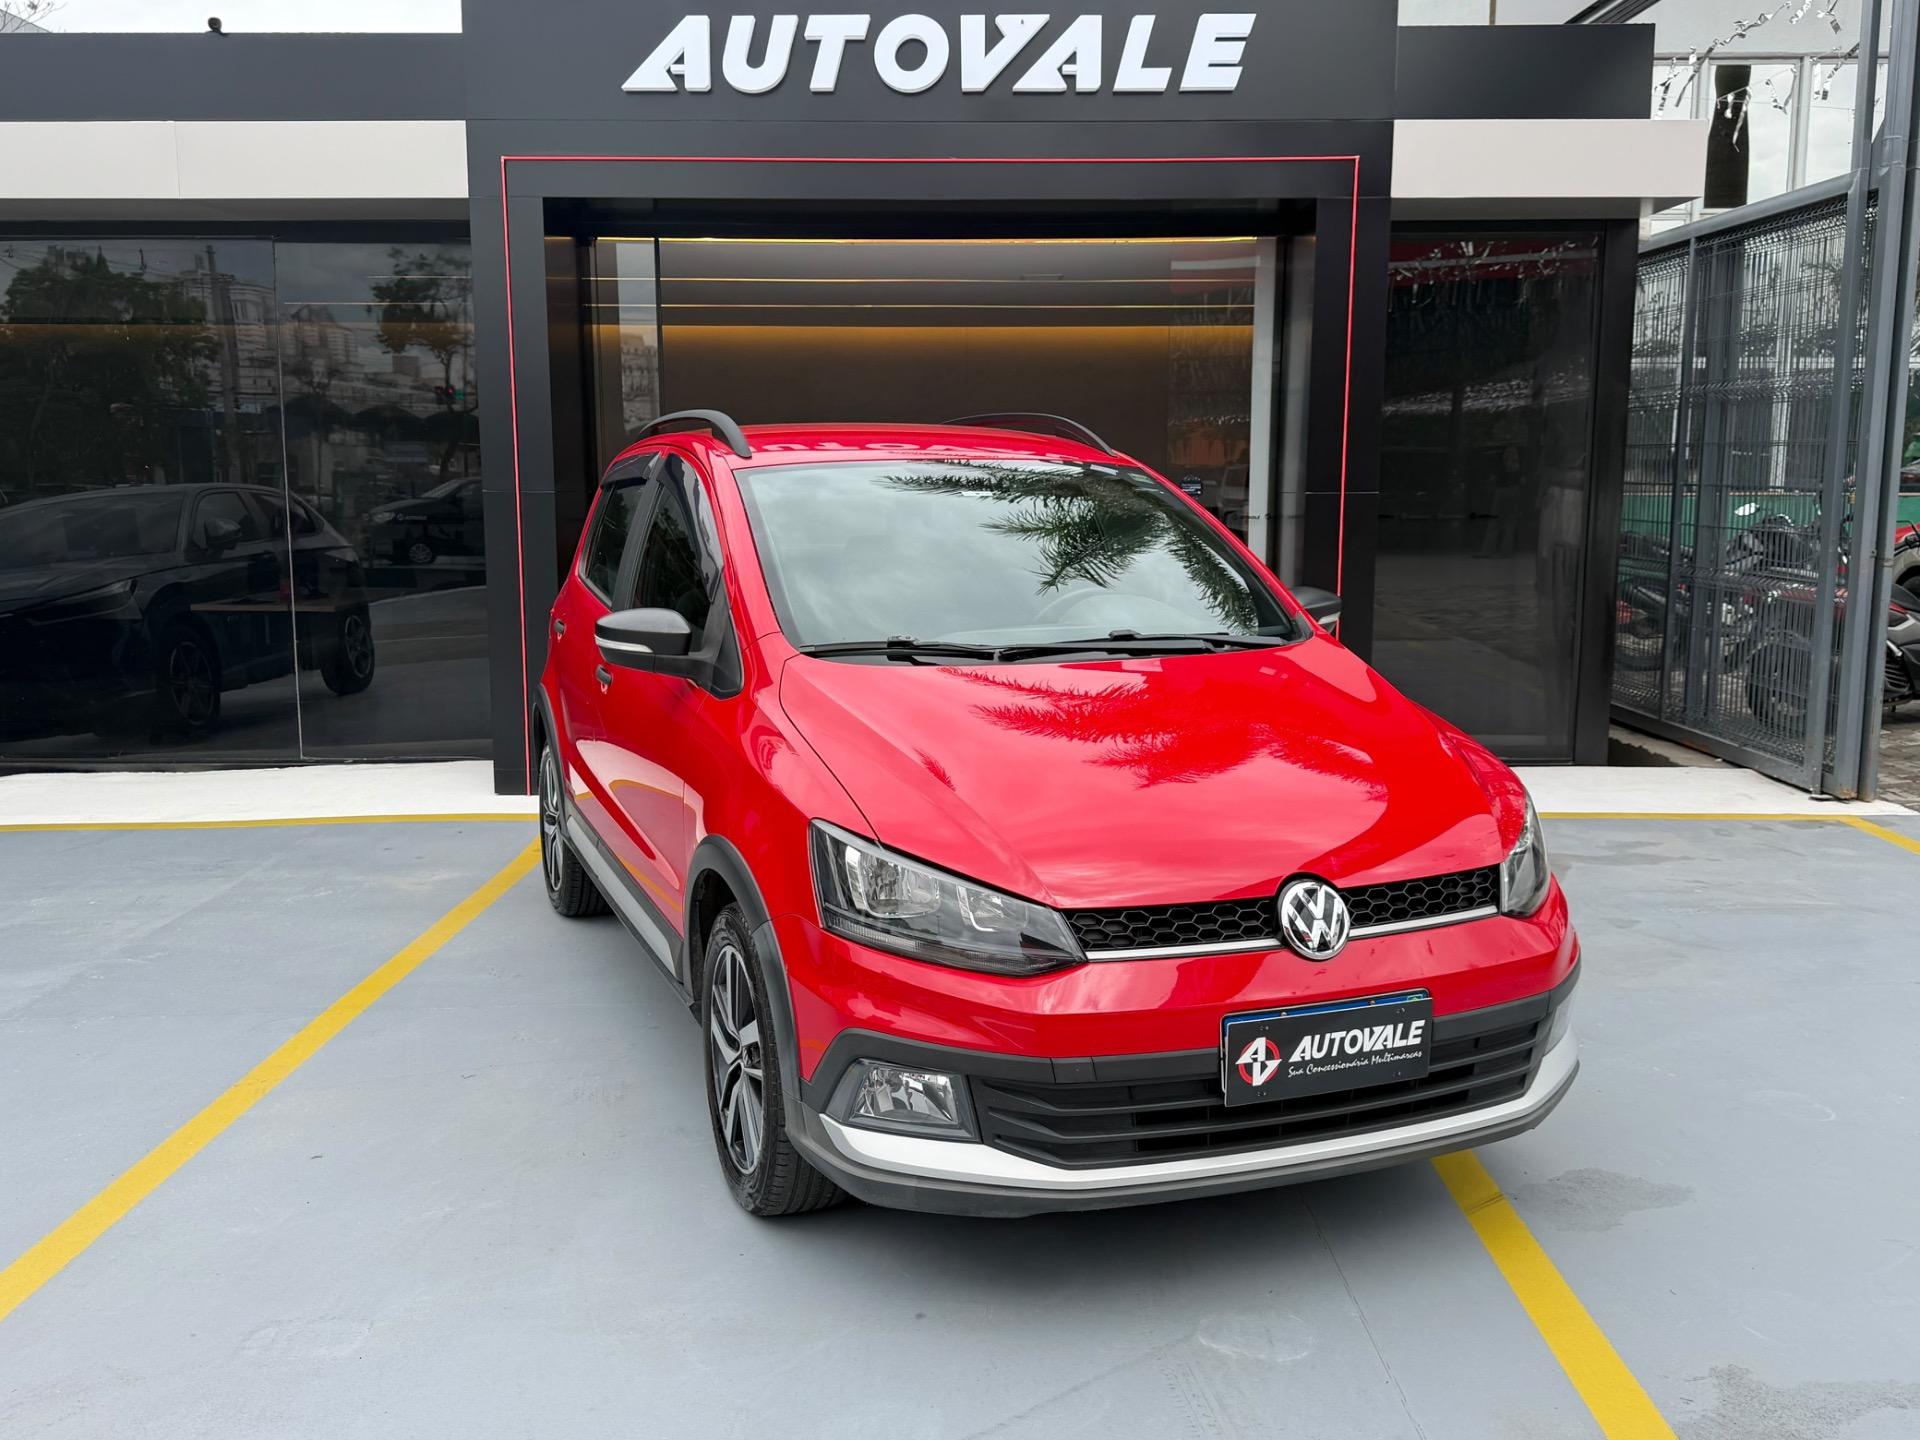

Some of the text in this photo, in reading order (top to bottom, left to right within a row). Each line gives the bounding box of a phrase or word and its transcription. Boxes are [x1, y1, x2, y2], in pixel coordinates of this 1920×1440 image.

[621, 13, 1257, 93] AUTOVALE
[1288, 1020, 1426, 1062] AUTOVALE
[1288, 1066, 1304, 1078] Sua
[1371, 1051, 1422, 1065] Multimarcas
